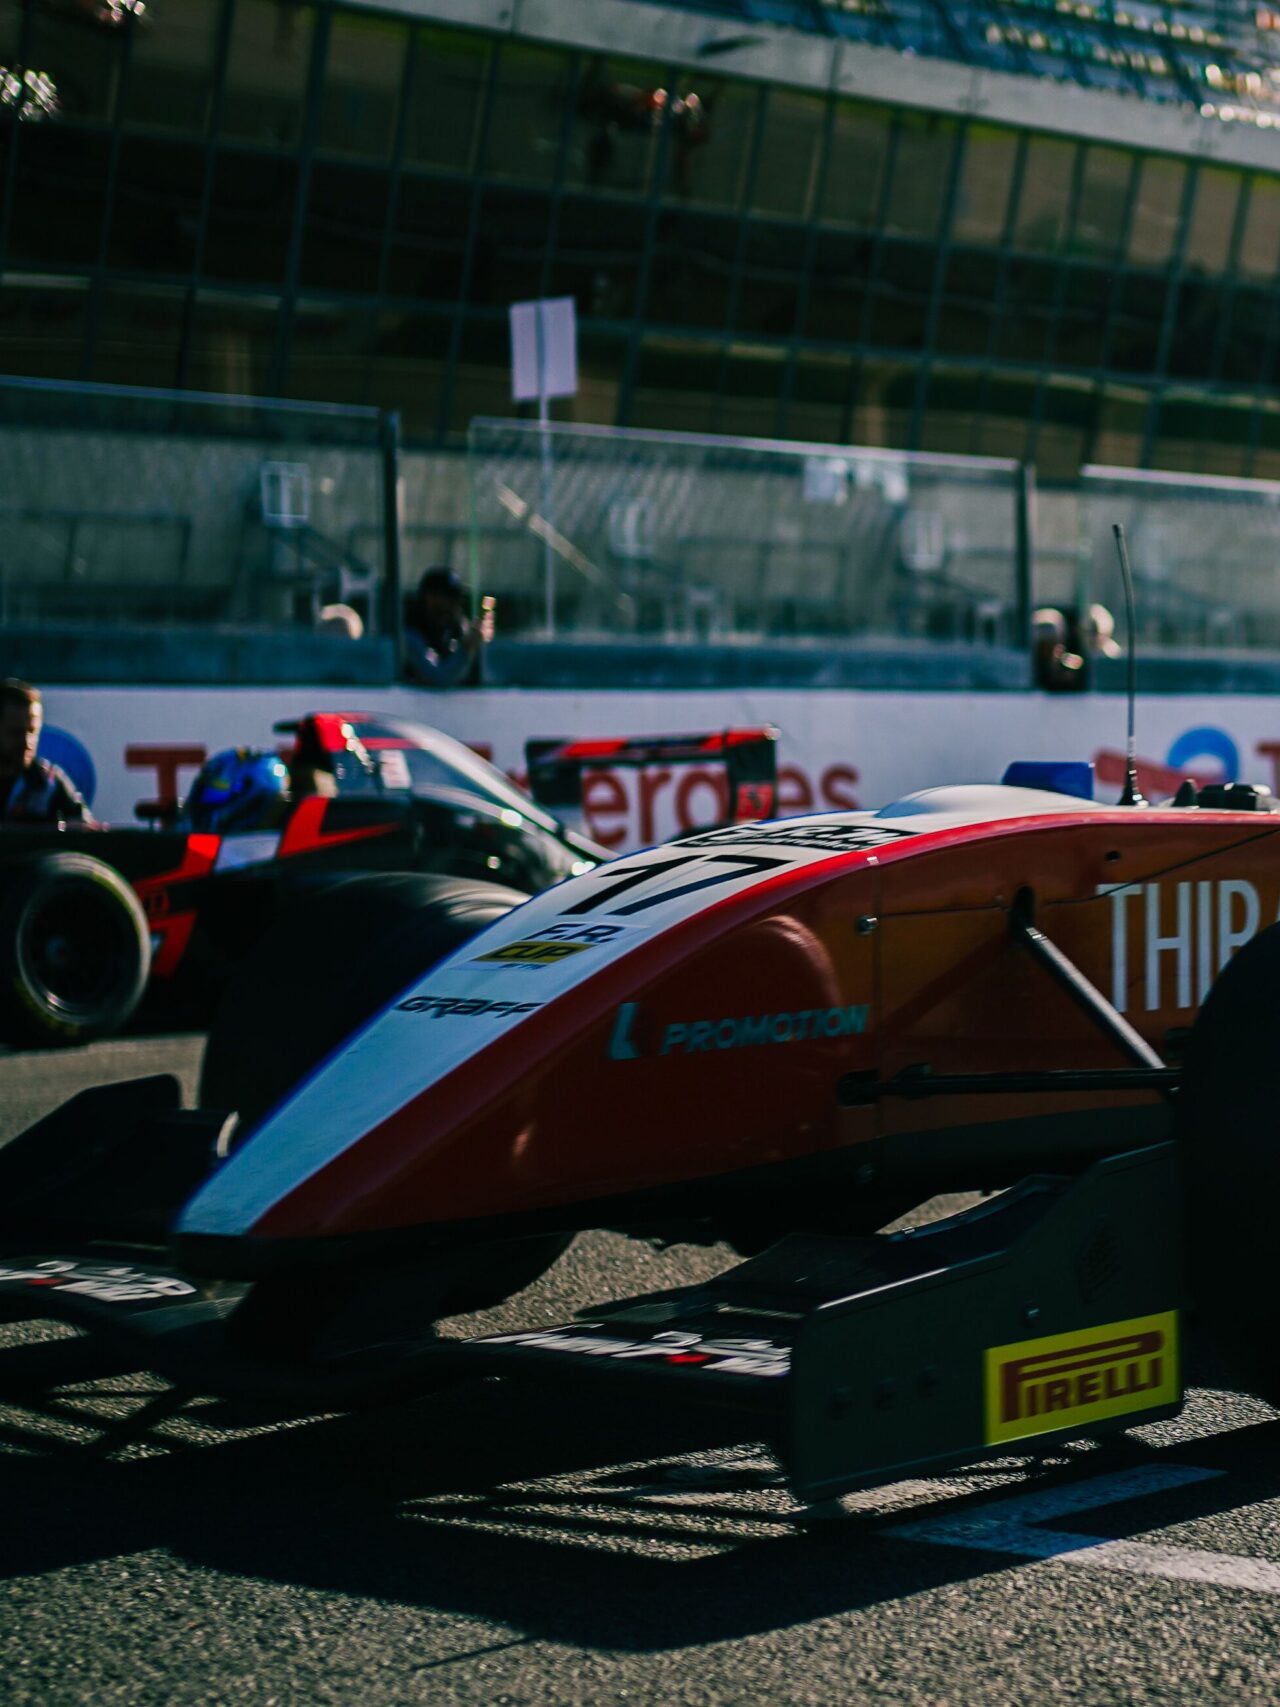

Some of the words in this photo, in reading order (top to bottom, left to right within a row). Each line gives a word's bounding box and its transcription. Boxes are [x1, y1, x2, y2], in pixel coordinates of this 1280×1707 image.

[557, 854, 798, 915] 17
[490, 945, 578, 960] CUP
[659, 1004, 870, 1056] PROMOTION
[1000, 1329, 1165, 1424] PIRELLI
